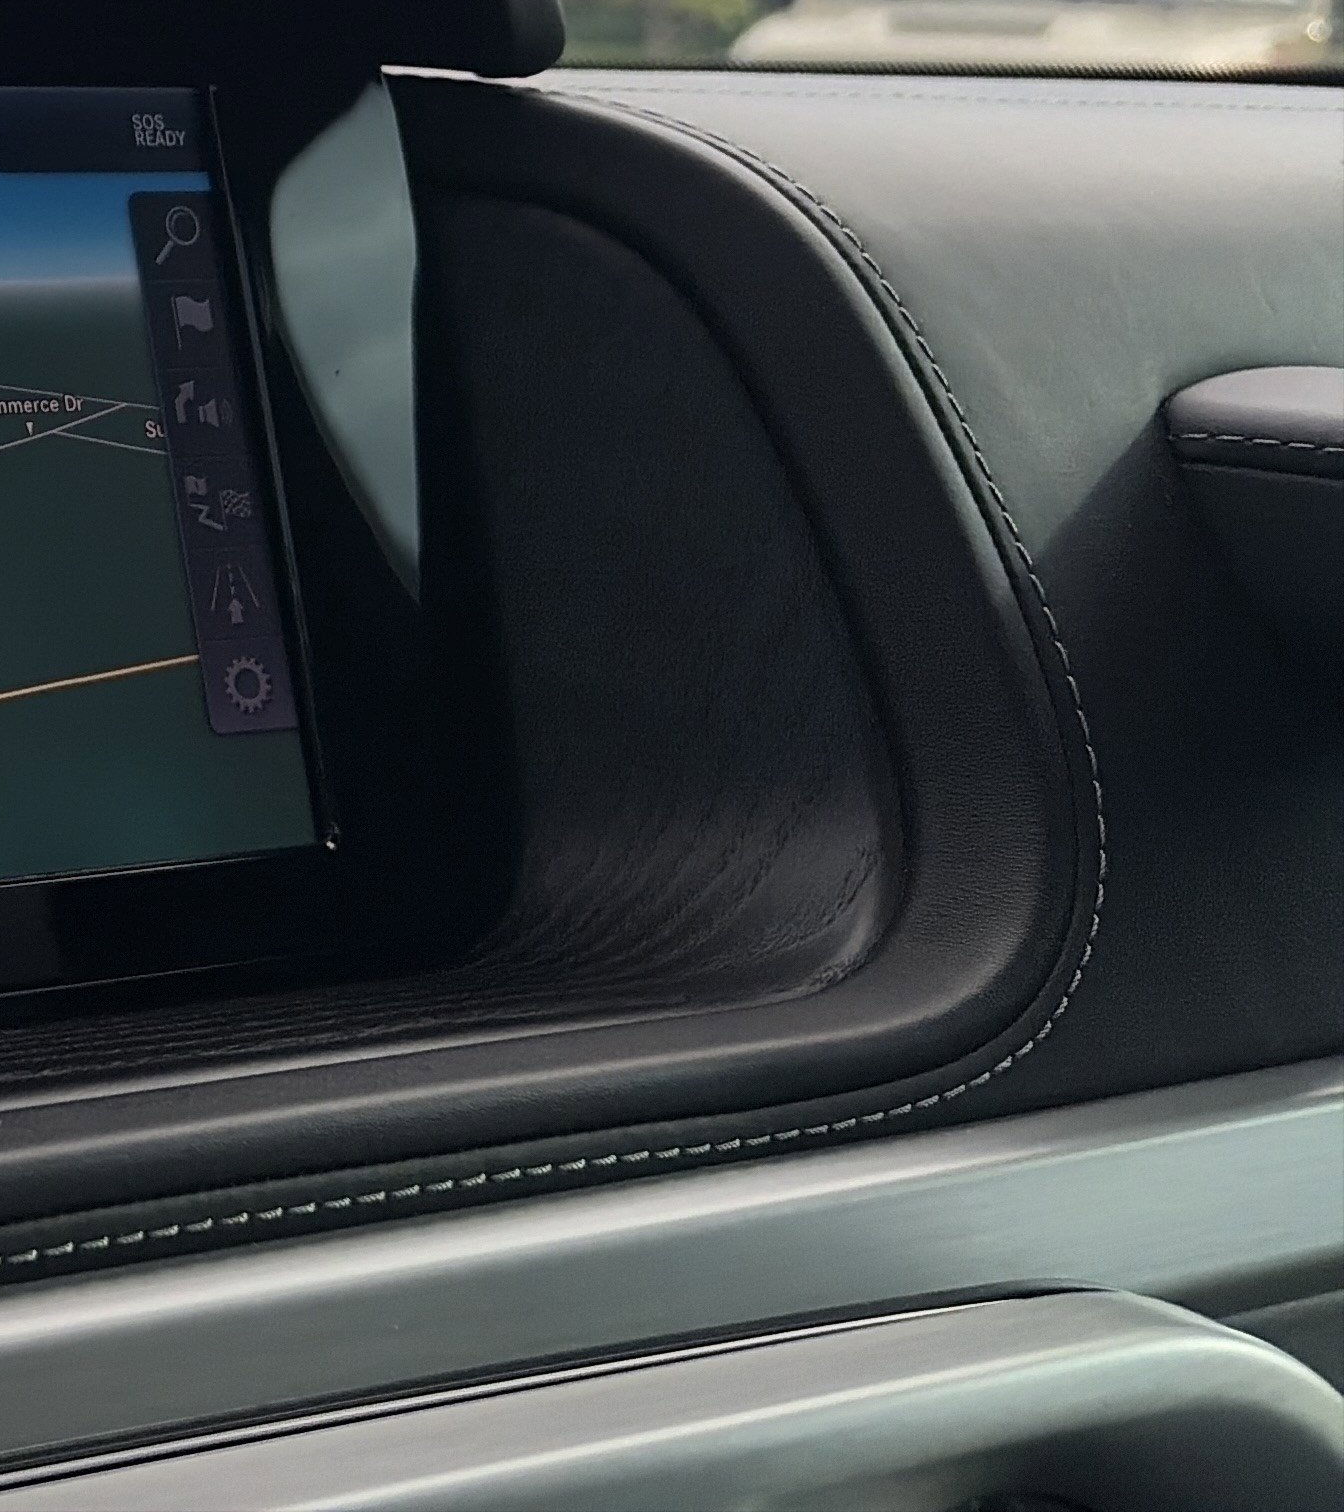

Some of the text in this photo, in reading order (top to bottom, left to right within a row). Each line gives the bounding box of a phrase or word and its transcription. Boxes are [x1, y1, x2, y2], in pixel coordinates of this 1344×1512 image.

[131, 113, 165, 130] SOS
[135, 129, 185, 146] READY
[64, 394, 84, 412] Dr
